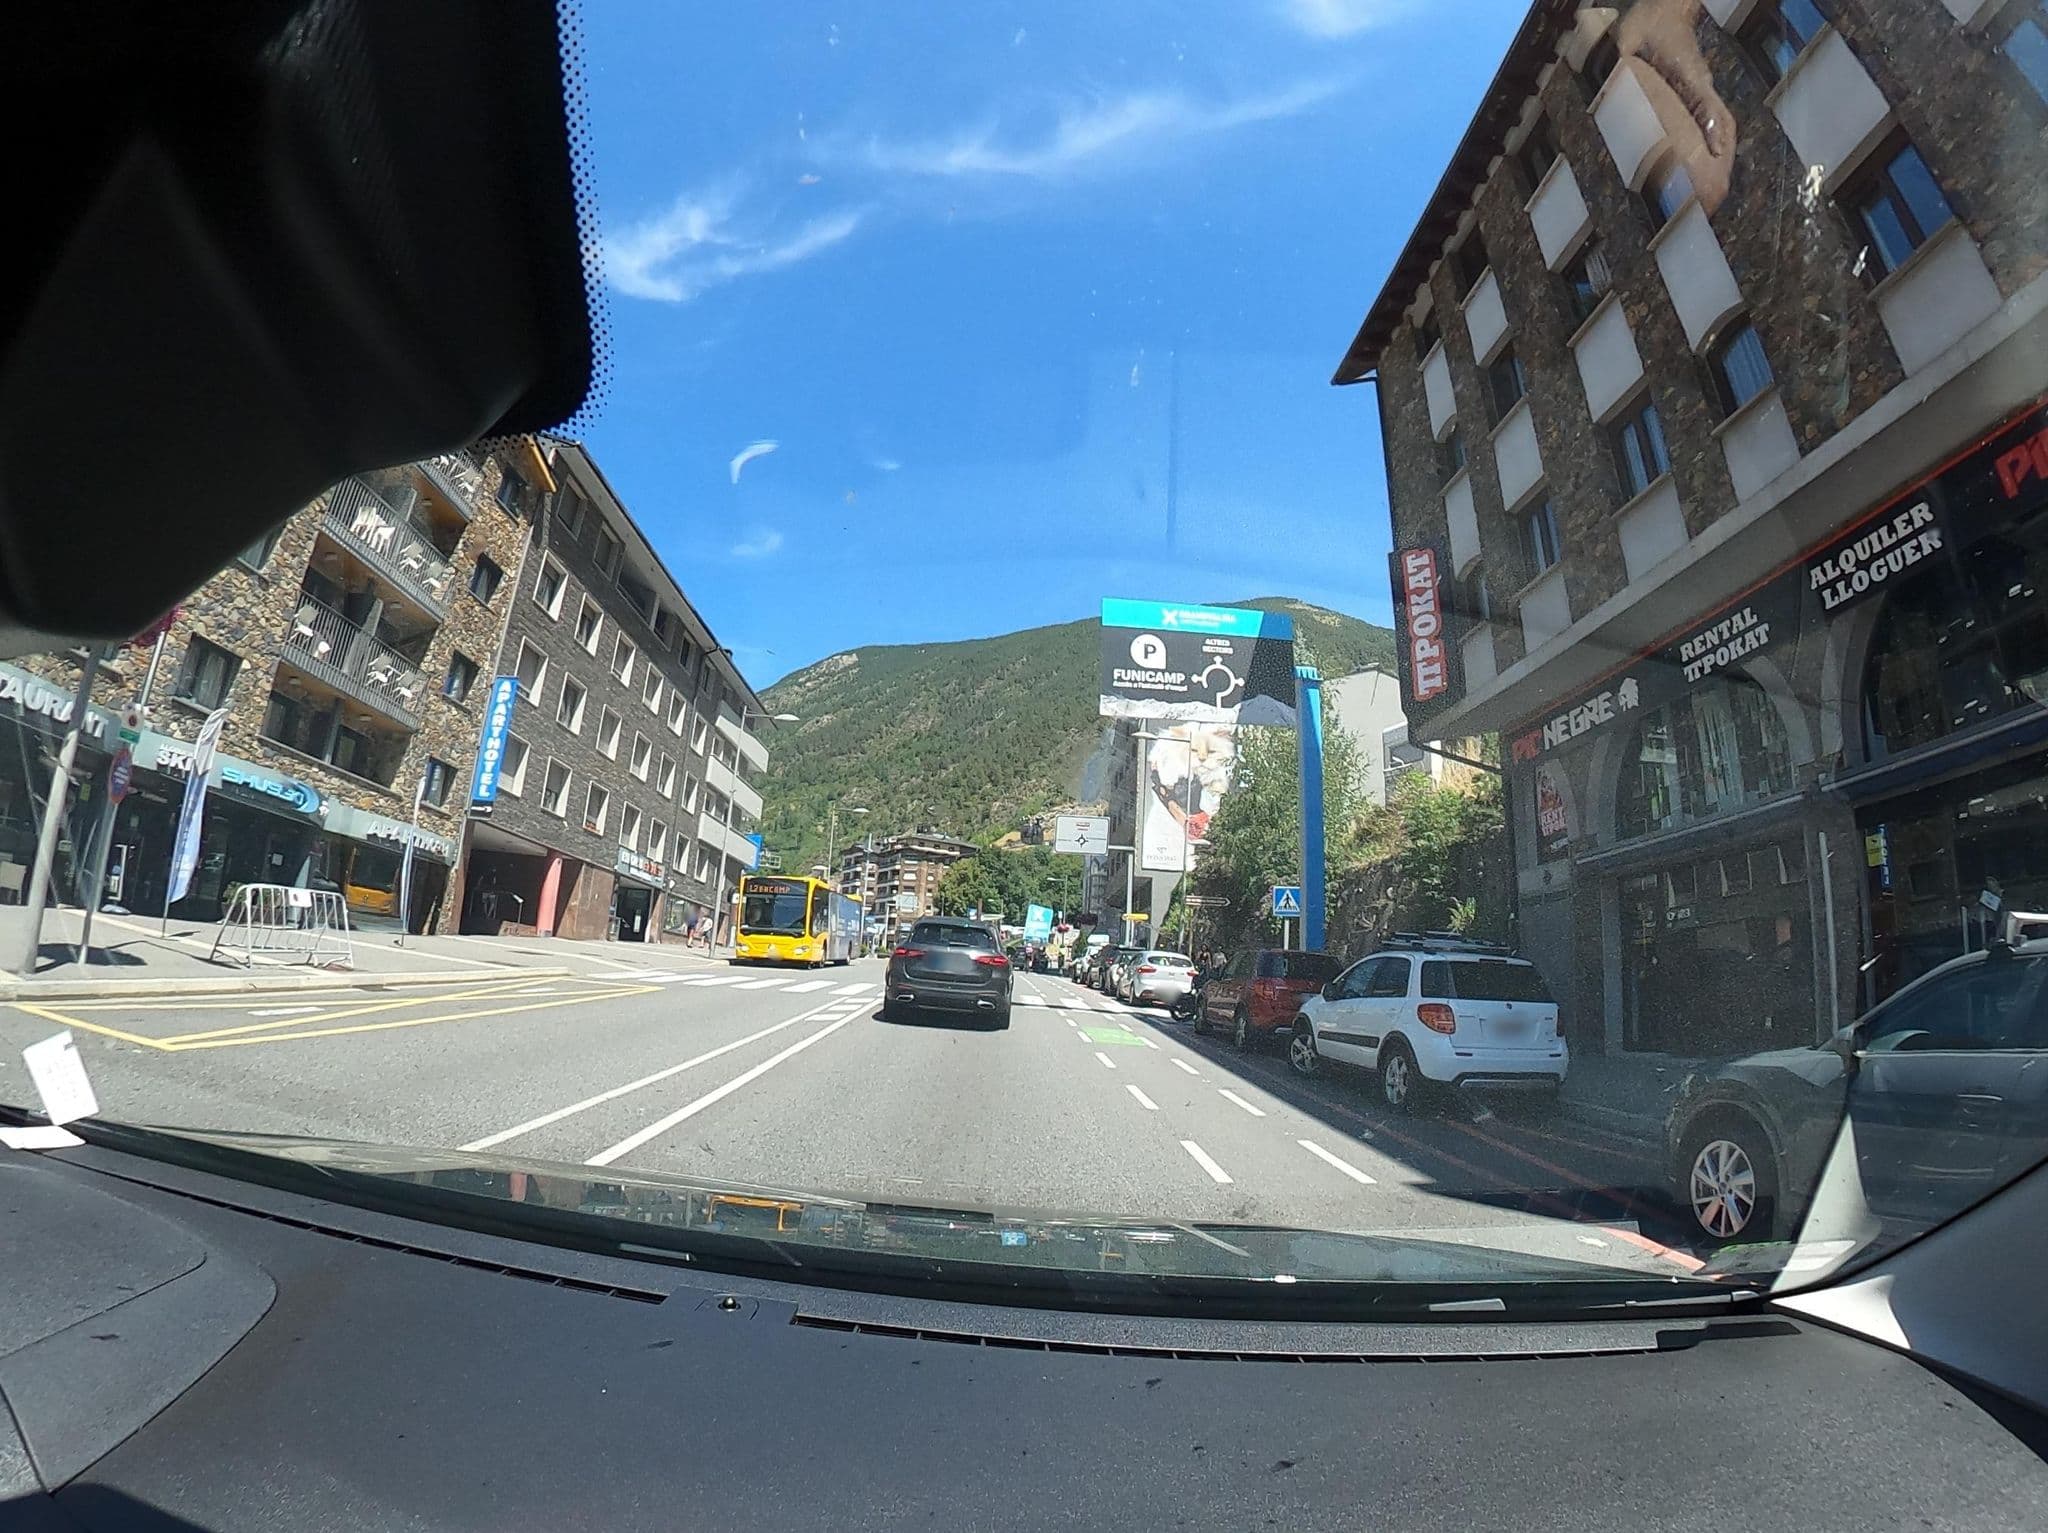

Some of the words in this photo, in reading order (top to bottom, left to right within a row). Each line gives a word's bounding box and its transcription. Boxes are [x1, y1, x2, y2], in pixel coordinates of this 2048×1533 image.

[1809, 501, 1935, 590] ALQUILER
[1821, 529, 1943, 611] LLOGUER
[1679, 606, 1759, 663] RENTAL
[1112, 668, 1186, 686] FUNICAMP
[478, 680, 512, 798] APARTHOTEL
[1543, 690, 1616, 751] NEGRE
